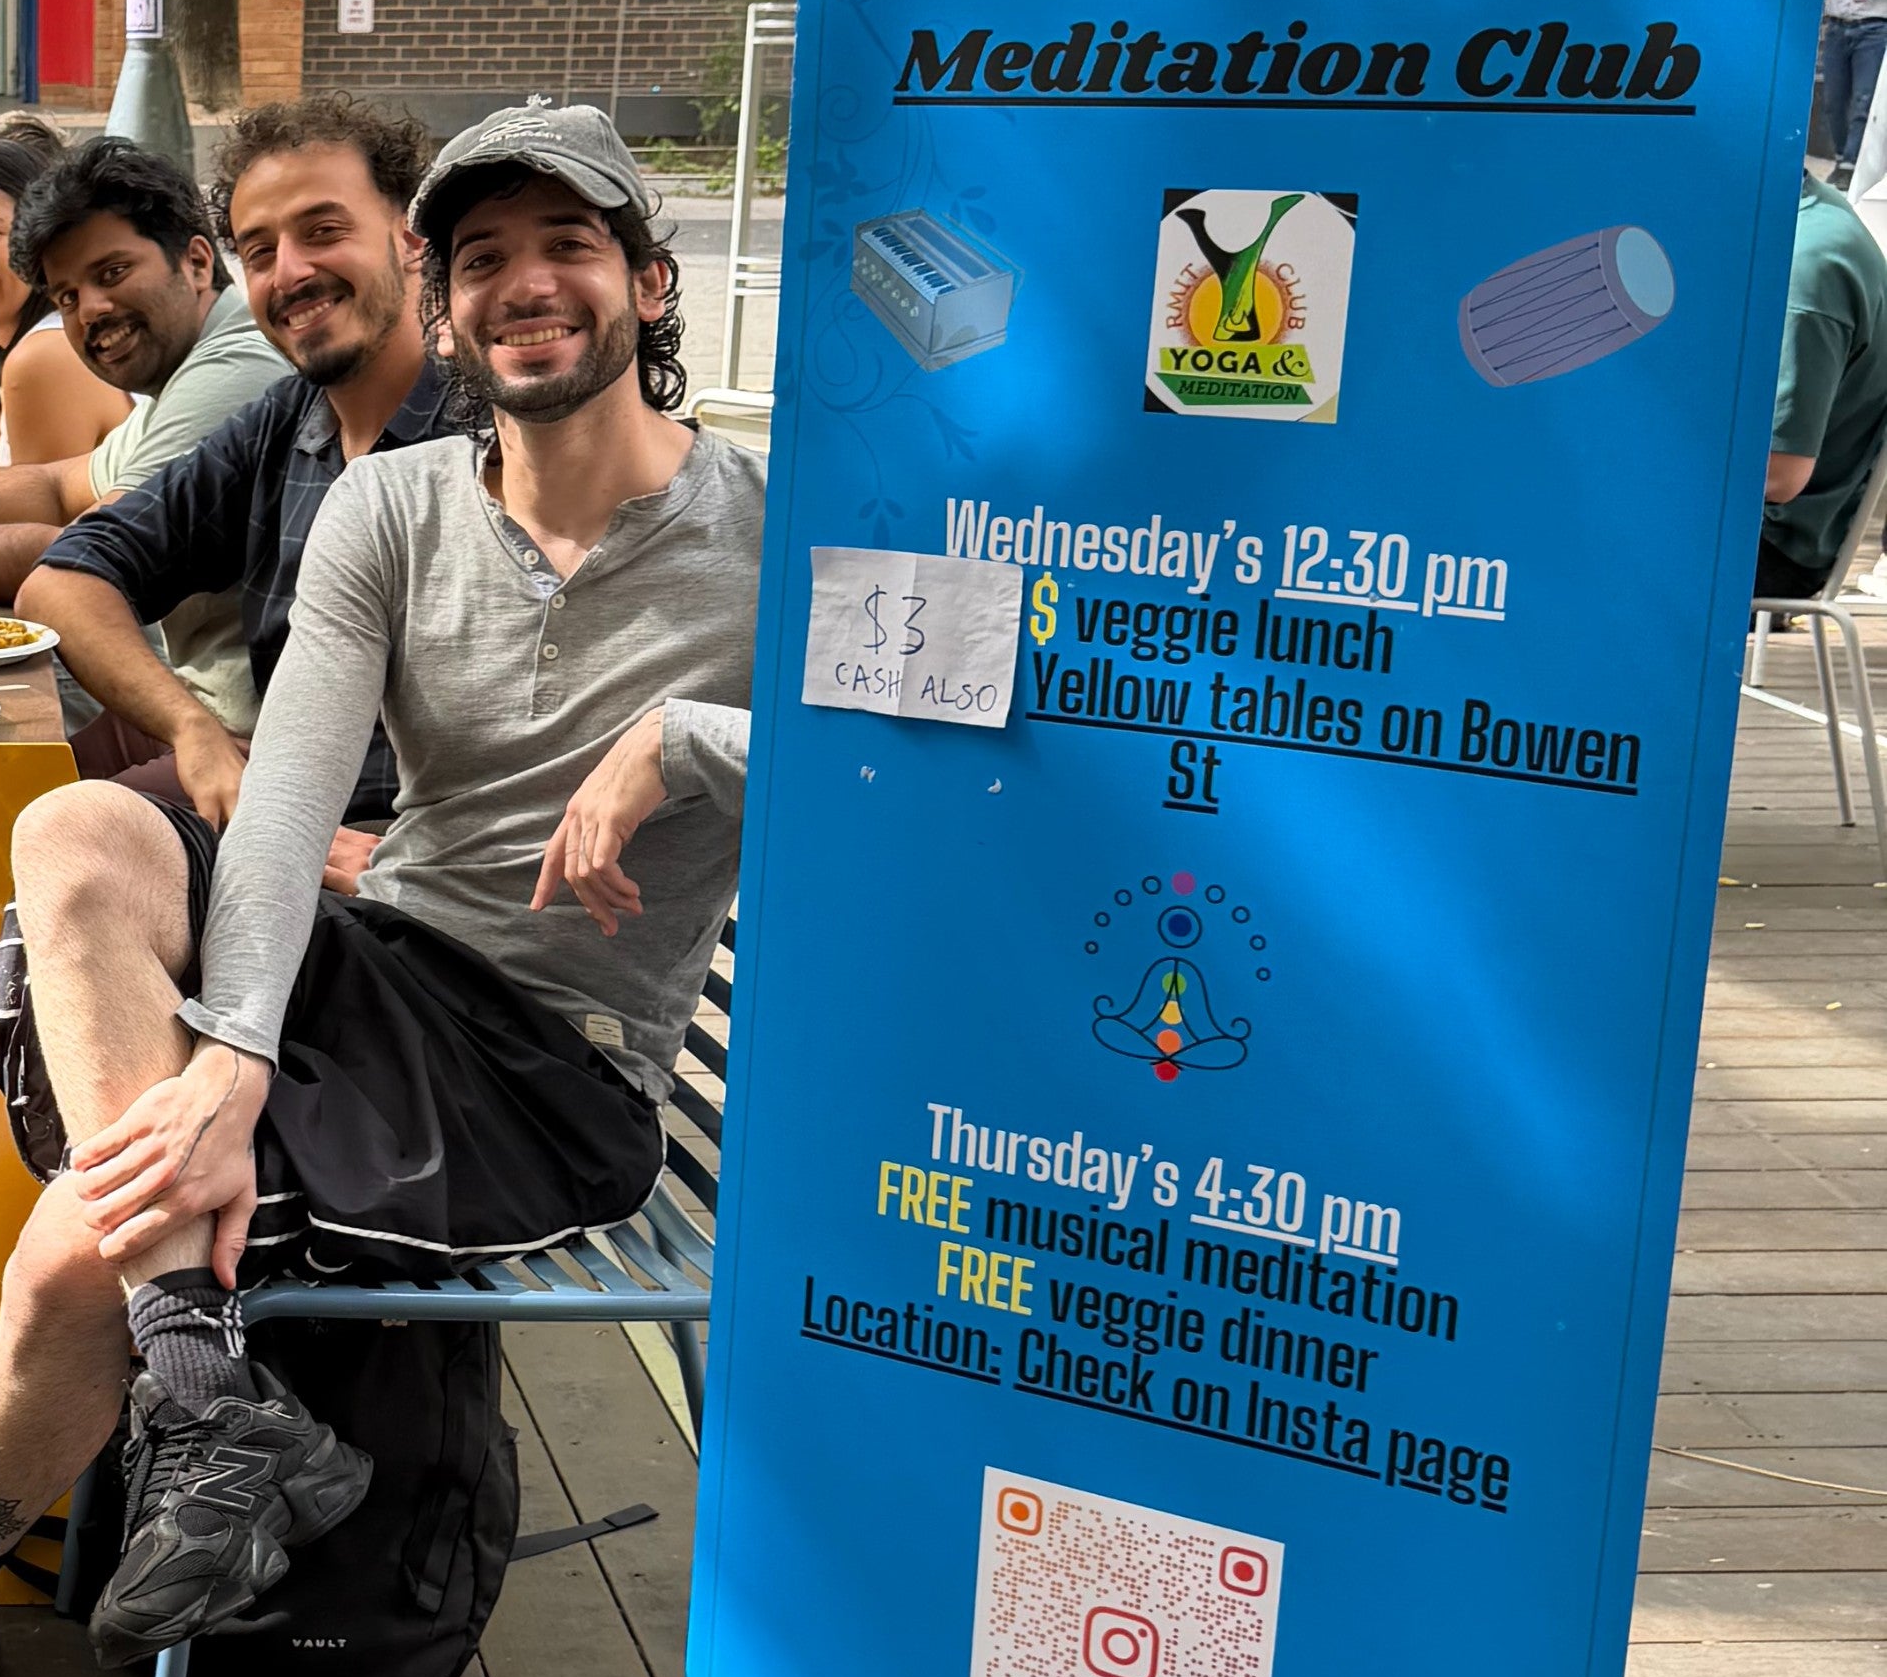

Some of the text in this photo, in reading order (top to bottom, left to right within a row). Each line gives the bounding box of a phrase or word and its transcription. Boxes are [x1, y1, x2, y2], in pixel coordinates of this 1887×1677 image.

[893, 20, 1701, 100] Meditation Club
[1166, 262, 1200, 329] RMIT
[1275, 262, 1307, 330] CLUB
[1169, 348, 1307, 377] YOGA &
[1177, 380, 1300, 400] MEDITATION
[946, 497, 1509, 617] Wednesday's 12:30 pm
[862, 584, 927, 655] $3
[1029, 572, 1394, 674] $ veggie lunch
[835, 662, 998, 712] CASH ALSO
[1032, 652, 1642, 783] Yellow tables on Bowen
[1168, 739, 1222, 803] St
[926, 1102, 1402, 1255] Thursday's 4:30 pm
[877, 1160, 1460, 1342] FREE musical meditation
[936, 1241, 1380, 1393] FREE veggie dinner
[803, 1275, 1510, 1503] Location: Check on Insta page
[292, 1638, 347, 1648] VAULT
